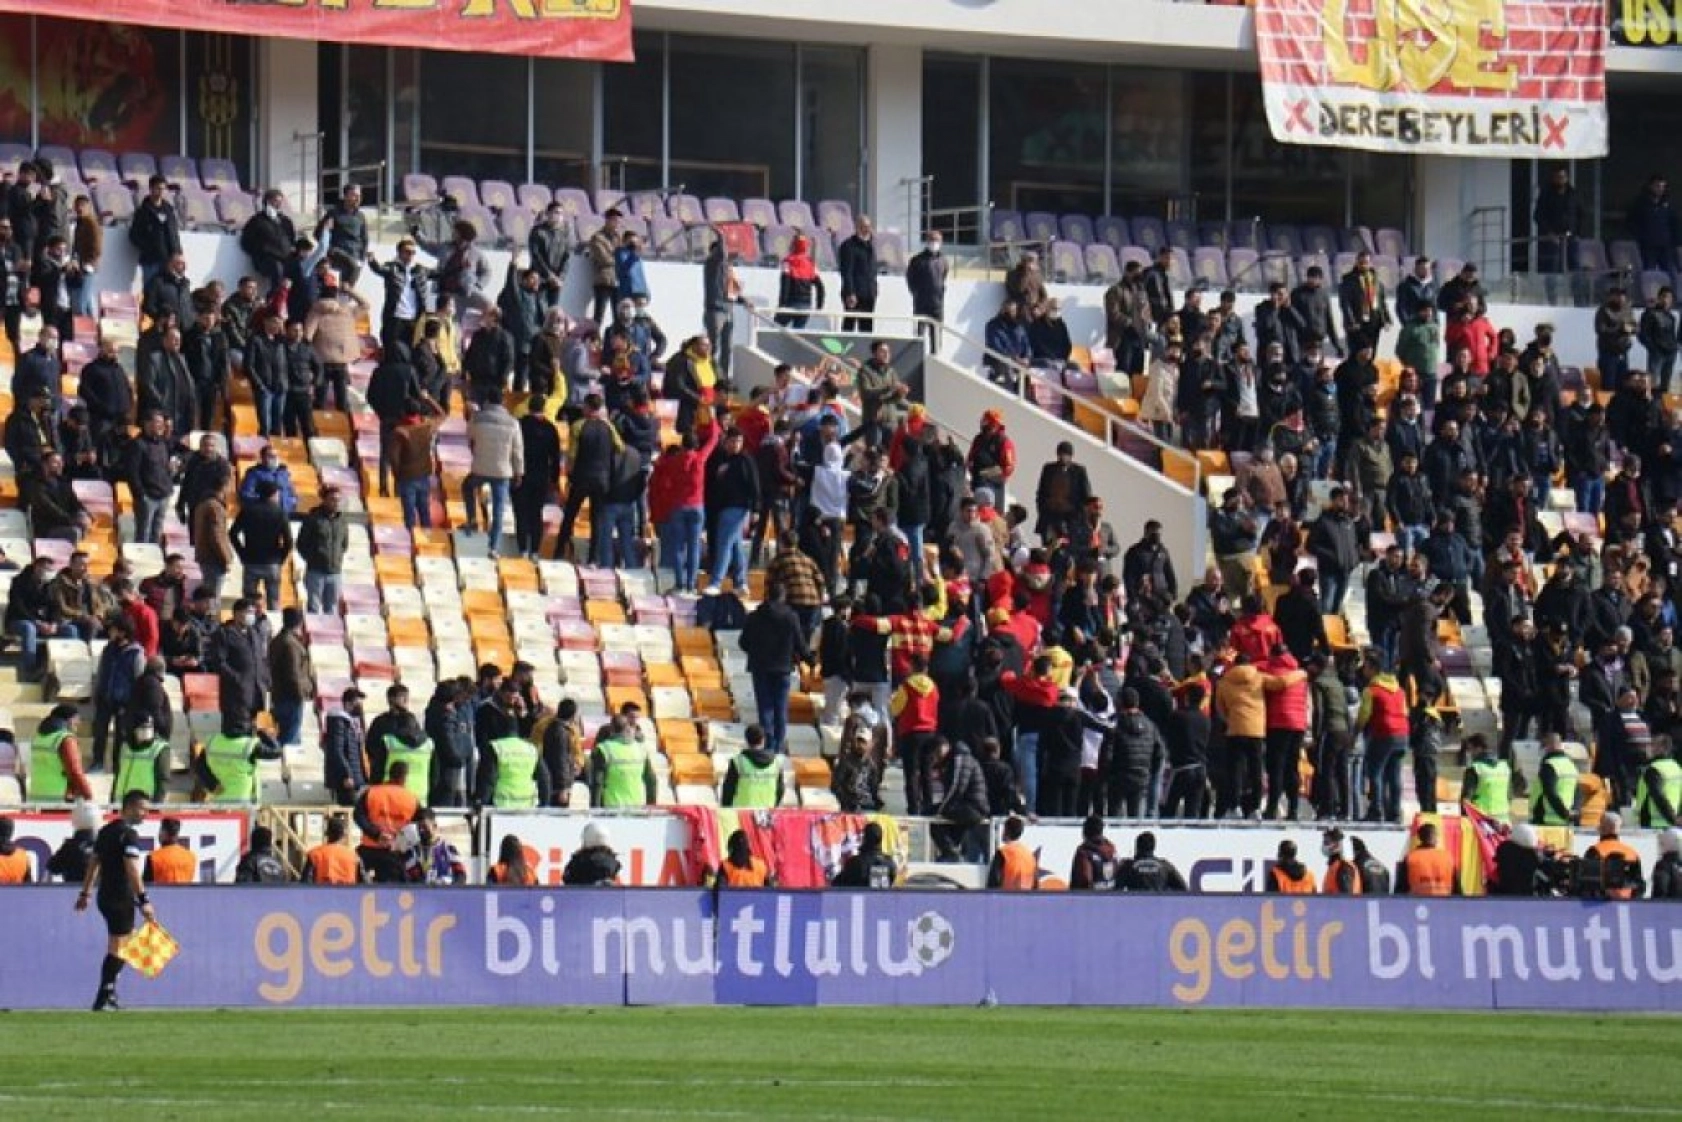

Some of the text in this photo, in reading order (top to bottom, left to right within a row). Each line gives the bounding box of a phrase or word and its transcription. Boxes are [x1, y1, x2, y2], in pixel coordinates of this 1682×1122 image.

[255, 892, 924, 1001] getir bi mutlulu
[1170, 900, 1682, 1001] getir bi mutlu
